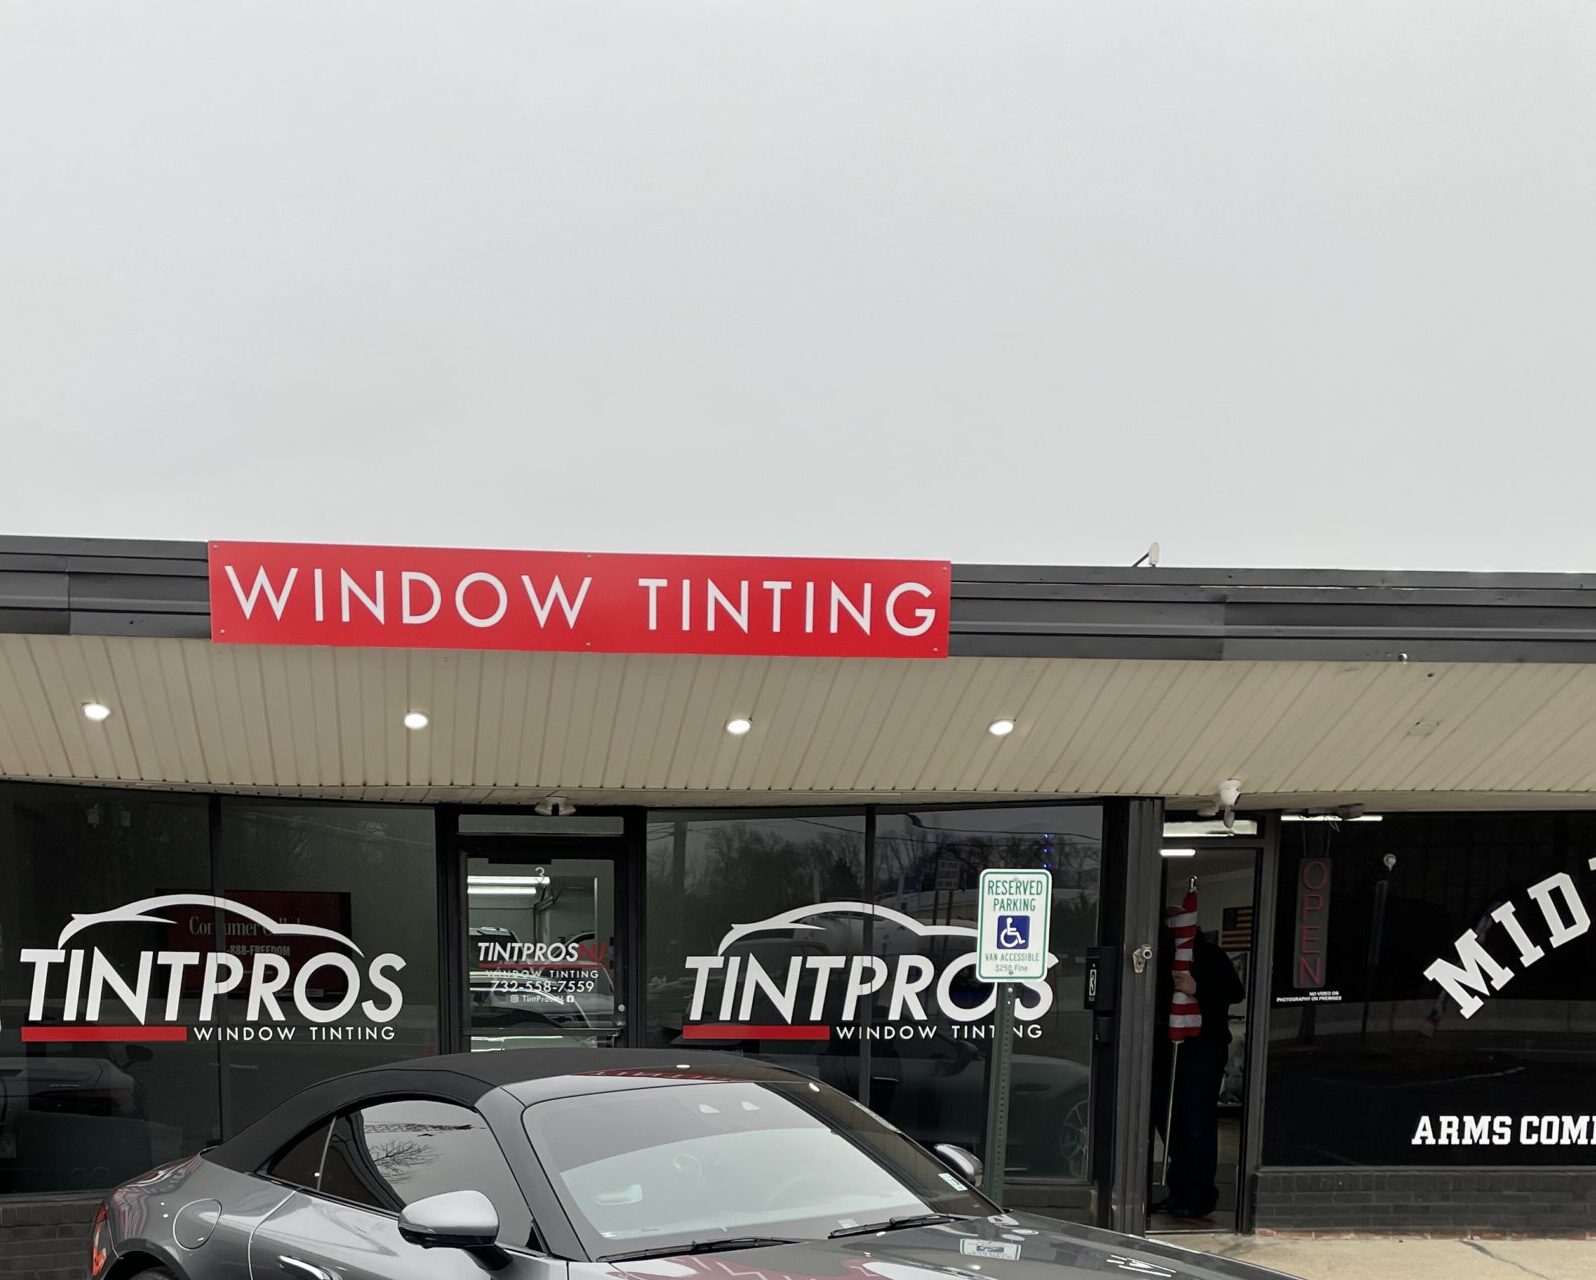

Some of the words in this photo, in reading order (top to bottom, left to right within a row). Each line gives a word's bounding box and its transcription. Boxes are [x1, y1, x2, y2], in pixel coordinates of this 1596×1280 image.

[225, 565, 593, 629] WINDOW
[638, 578, 937, 638] TINTING
[988, 880, 1043, 895] RESERVED
[993, 898, 1036, 912] PARKING
[1300, 860, 1328, 988] OPEN
[1423, 857, 1596, 1020] MID
[985, 952, 999, 962] VAN
[1000, 952, 1040, 962] ACCESSIBLE
[549, 970, 600, 979] TINTING
[19, 946, 407, 1026] TINTPROS
[490, 980, 596, 993] 732-558-7559
[193, 1026, 296, 1041] WINDOW
[309, 1026, 396, 1041] TINTING
[836, 1025, 938, 1040] WINDOW
[951, 1024, 1043, 1039] TINTNG
[1411, 1115, 1512, 1145] ARMS
[1520, 1115, 1596, 1145] COM
